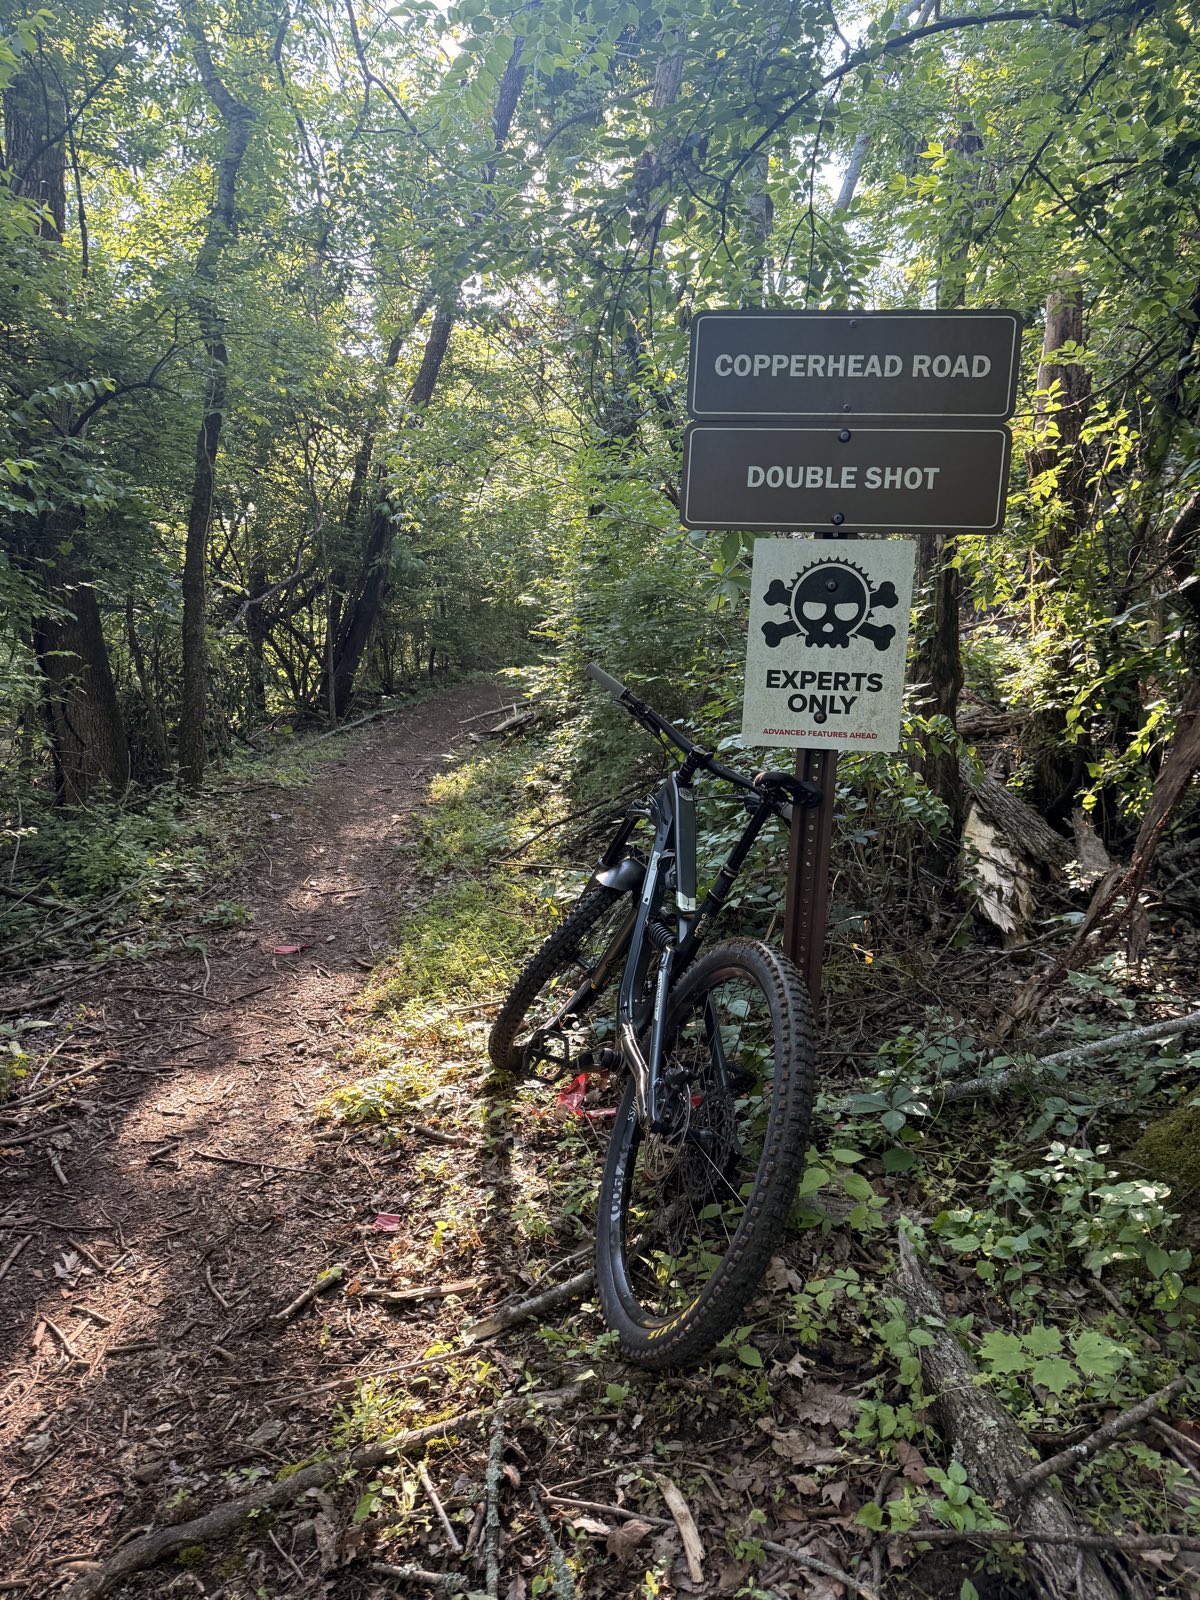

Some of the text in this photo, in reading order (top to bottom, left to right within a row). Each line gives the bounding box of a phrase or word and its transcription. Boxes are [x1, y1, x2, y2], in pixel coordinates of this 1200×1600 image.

[714, 354, 992, 378] COPPERHEAD ROAD
[747, 465, 940, 490] DOUBLE SHOT
[766, 669, 883, 693] EXPERTS
[787, 693, 858, 715] ONLY
[763, 728, 878, 739] ADVANCED FEATURES AHEAD
